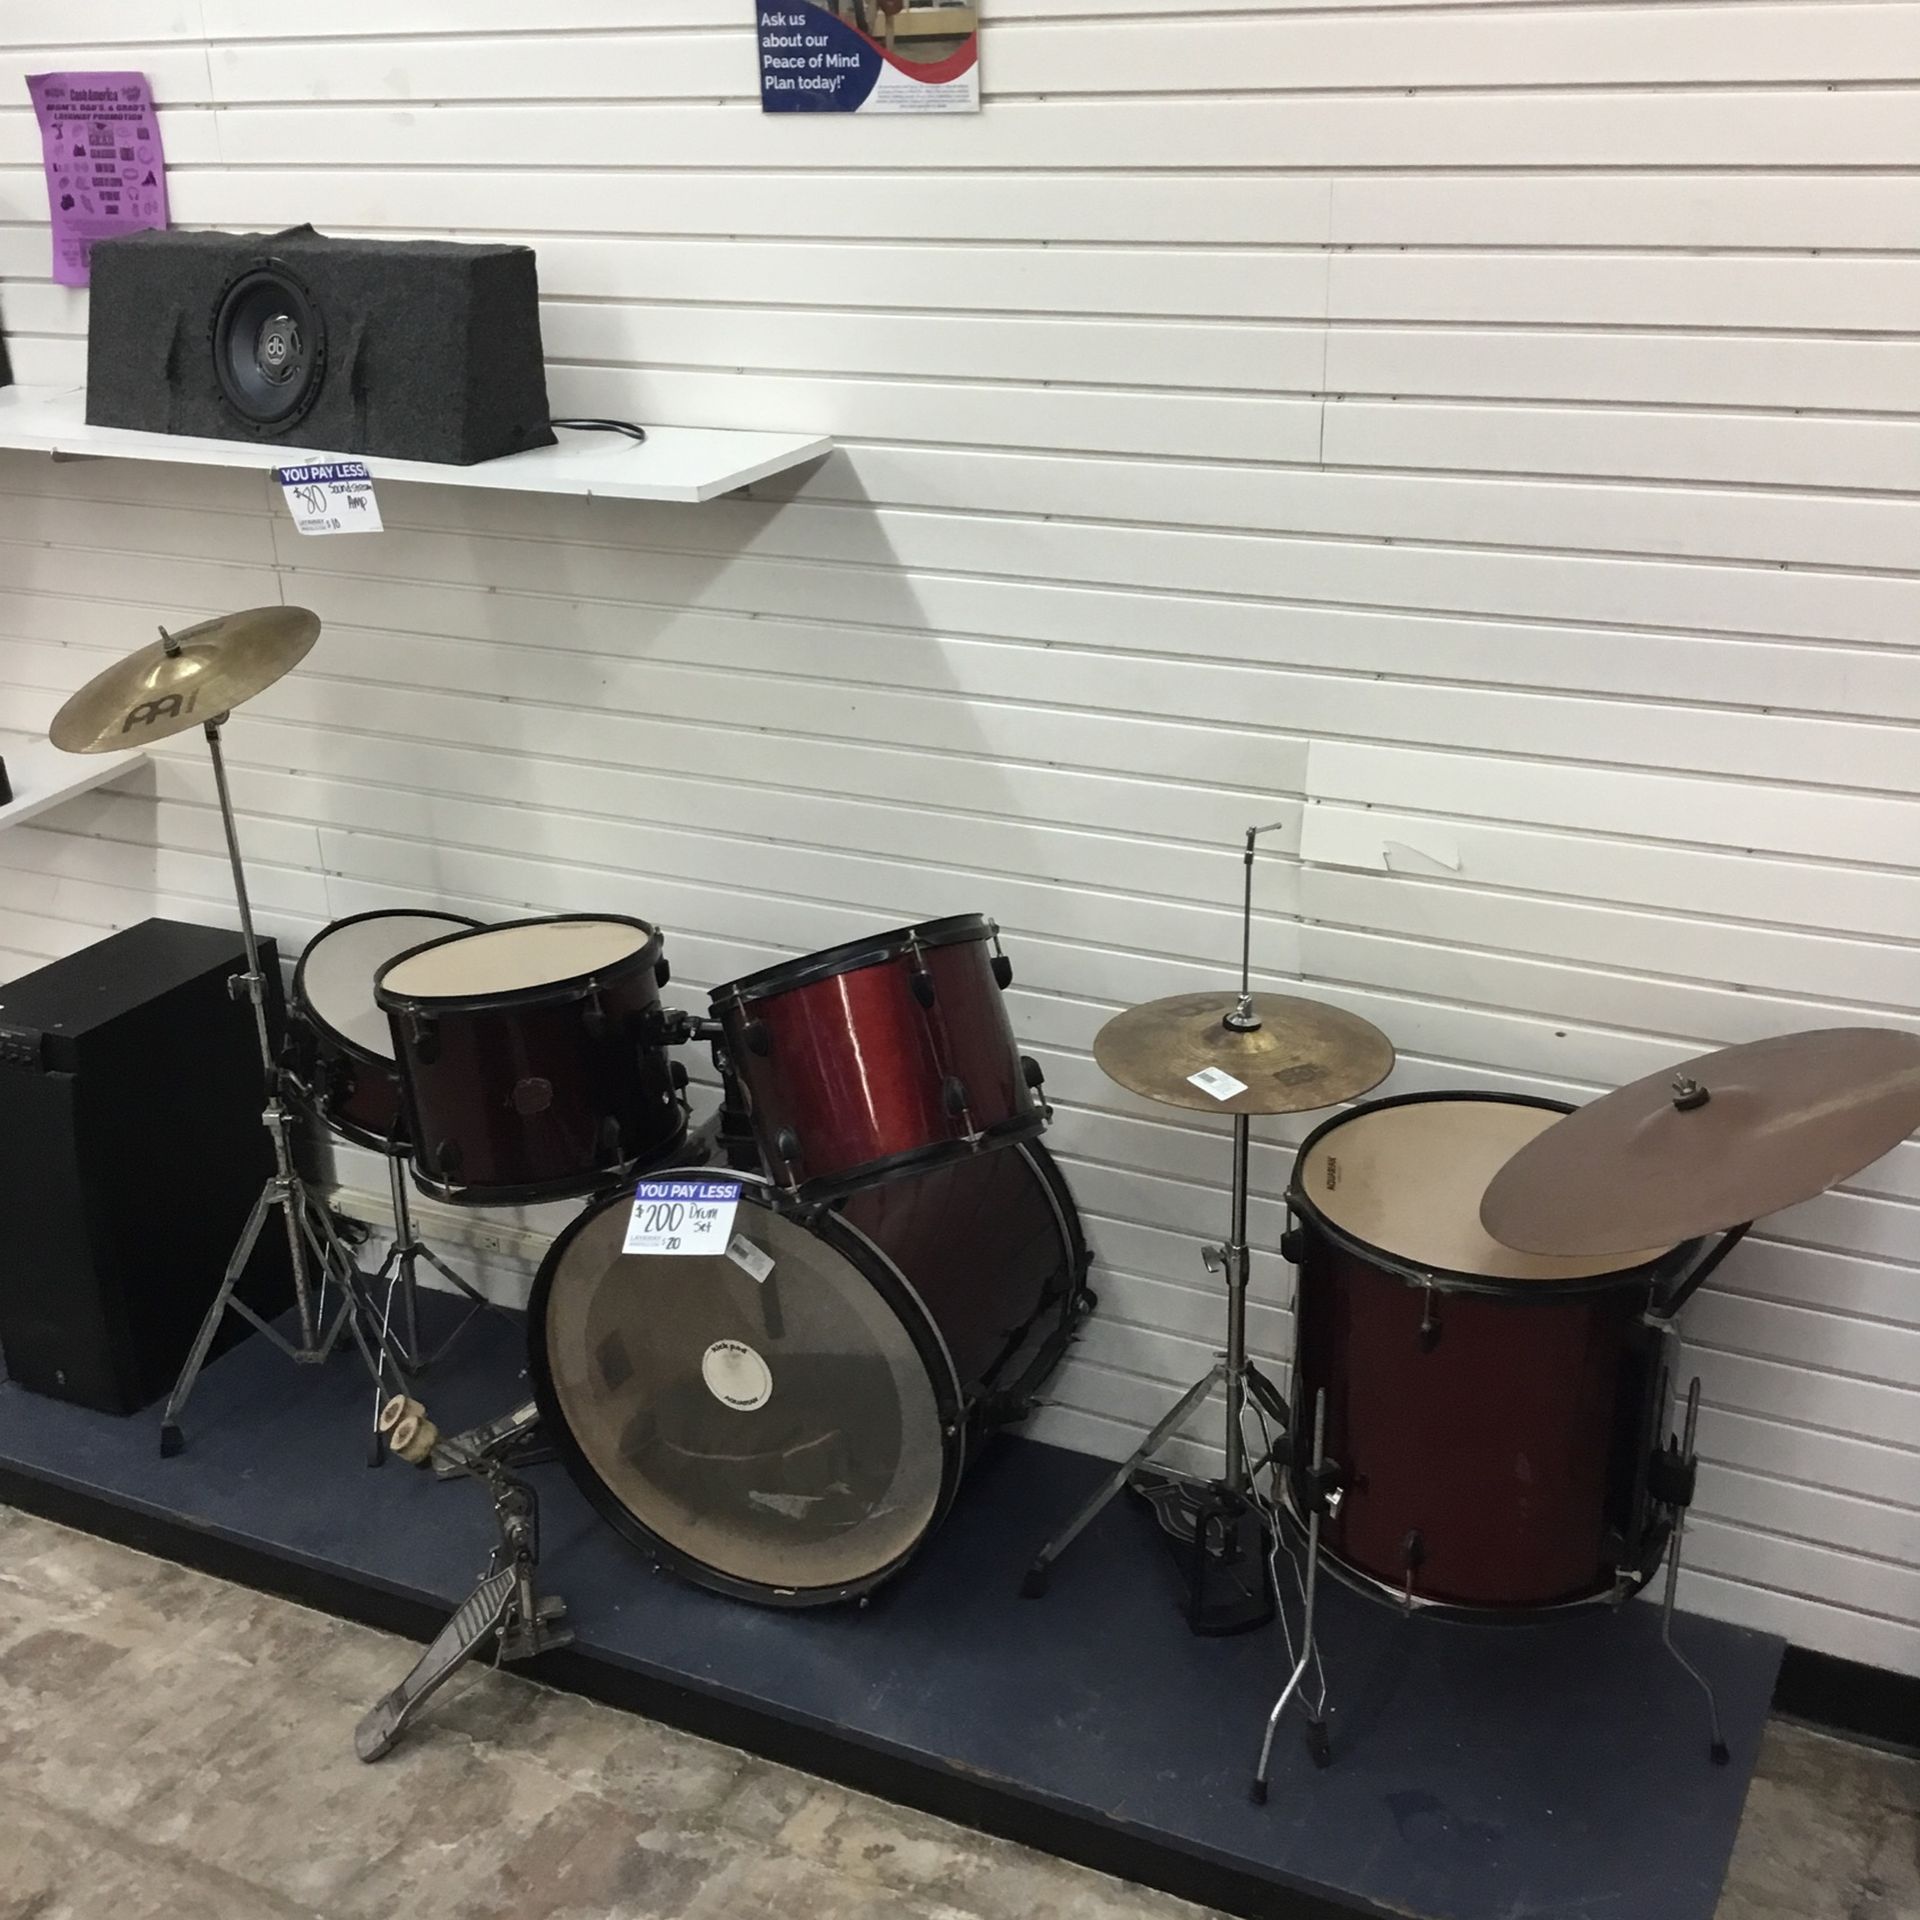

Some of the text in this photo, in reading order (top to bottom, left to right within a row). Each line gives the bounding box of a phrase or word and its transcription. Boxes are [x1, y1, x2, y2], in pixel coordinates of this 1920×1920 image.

[761, 12, 806, 26] Ask us
[762, 35, 829, 47] about our
[764, 54, 860, 68] Peace of Mind
[765, 76, 796, 89] Plan
[281, 464, 368, 482] YOU PAY LESS!
[293, 485, 327, 514] $80
[639, 1184, 738, 1198] YOU PAY LESS!
[635, 1203, 719, 1232] $200 Drum
[693, 1221, 711, 1233] Set
